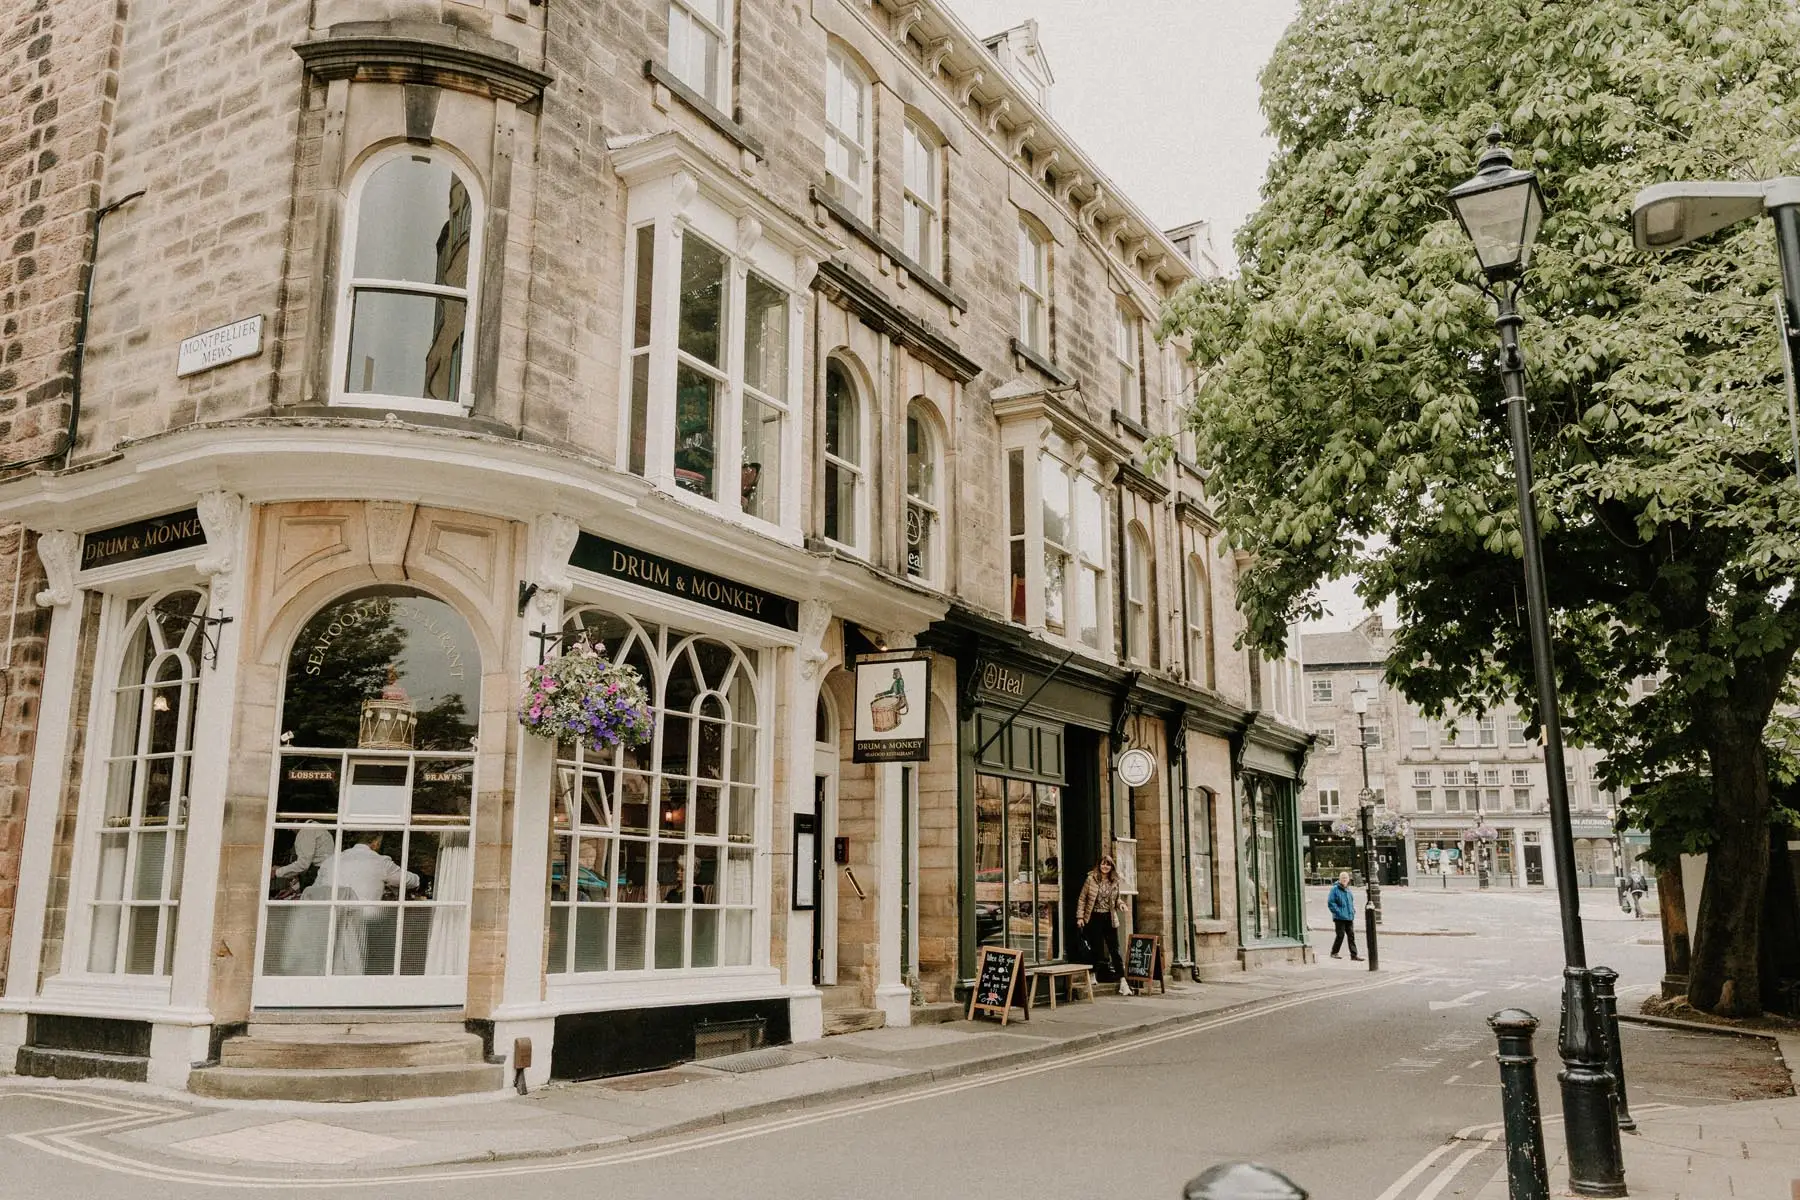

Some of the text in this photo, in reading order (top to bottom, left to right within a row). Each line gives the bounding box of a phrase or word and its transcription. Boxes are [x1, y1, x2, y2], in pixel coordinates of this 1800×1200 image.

[183, 321, 256, 356] MONTPELLIER
[201, 344, 233, 365] MEWS
[86, 518, 201, 560] DRUM & MONKE
[908, 551, 923, 567] eal
[612, 550, 764, 614] DRUM & MONKEY
[306, 602, 464, 680] SEAFOOD RESTAURANT
[996, 667, 1025, 696] Heal
[857, 742, 881, 750] DRUM
[889, 741, 922, 749] MONKEY
[425, 773, 462, 781] PRAWNS
